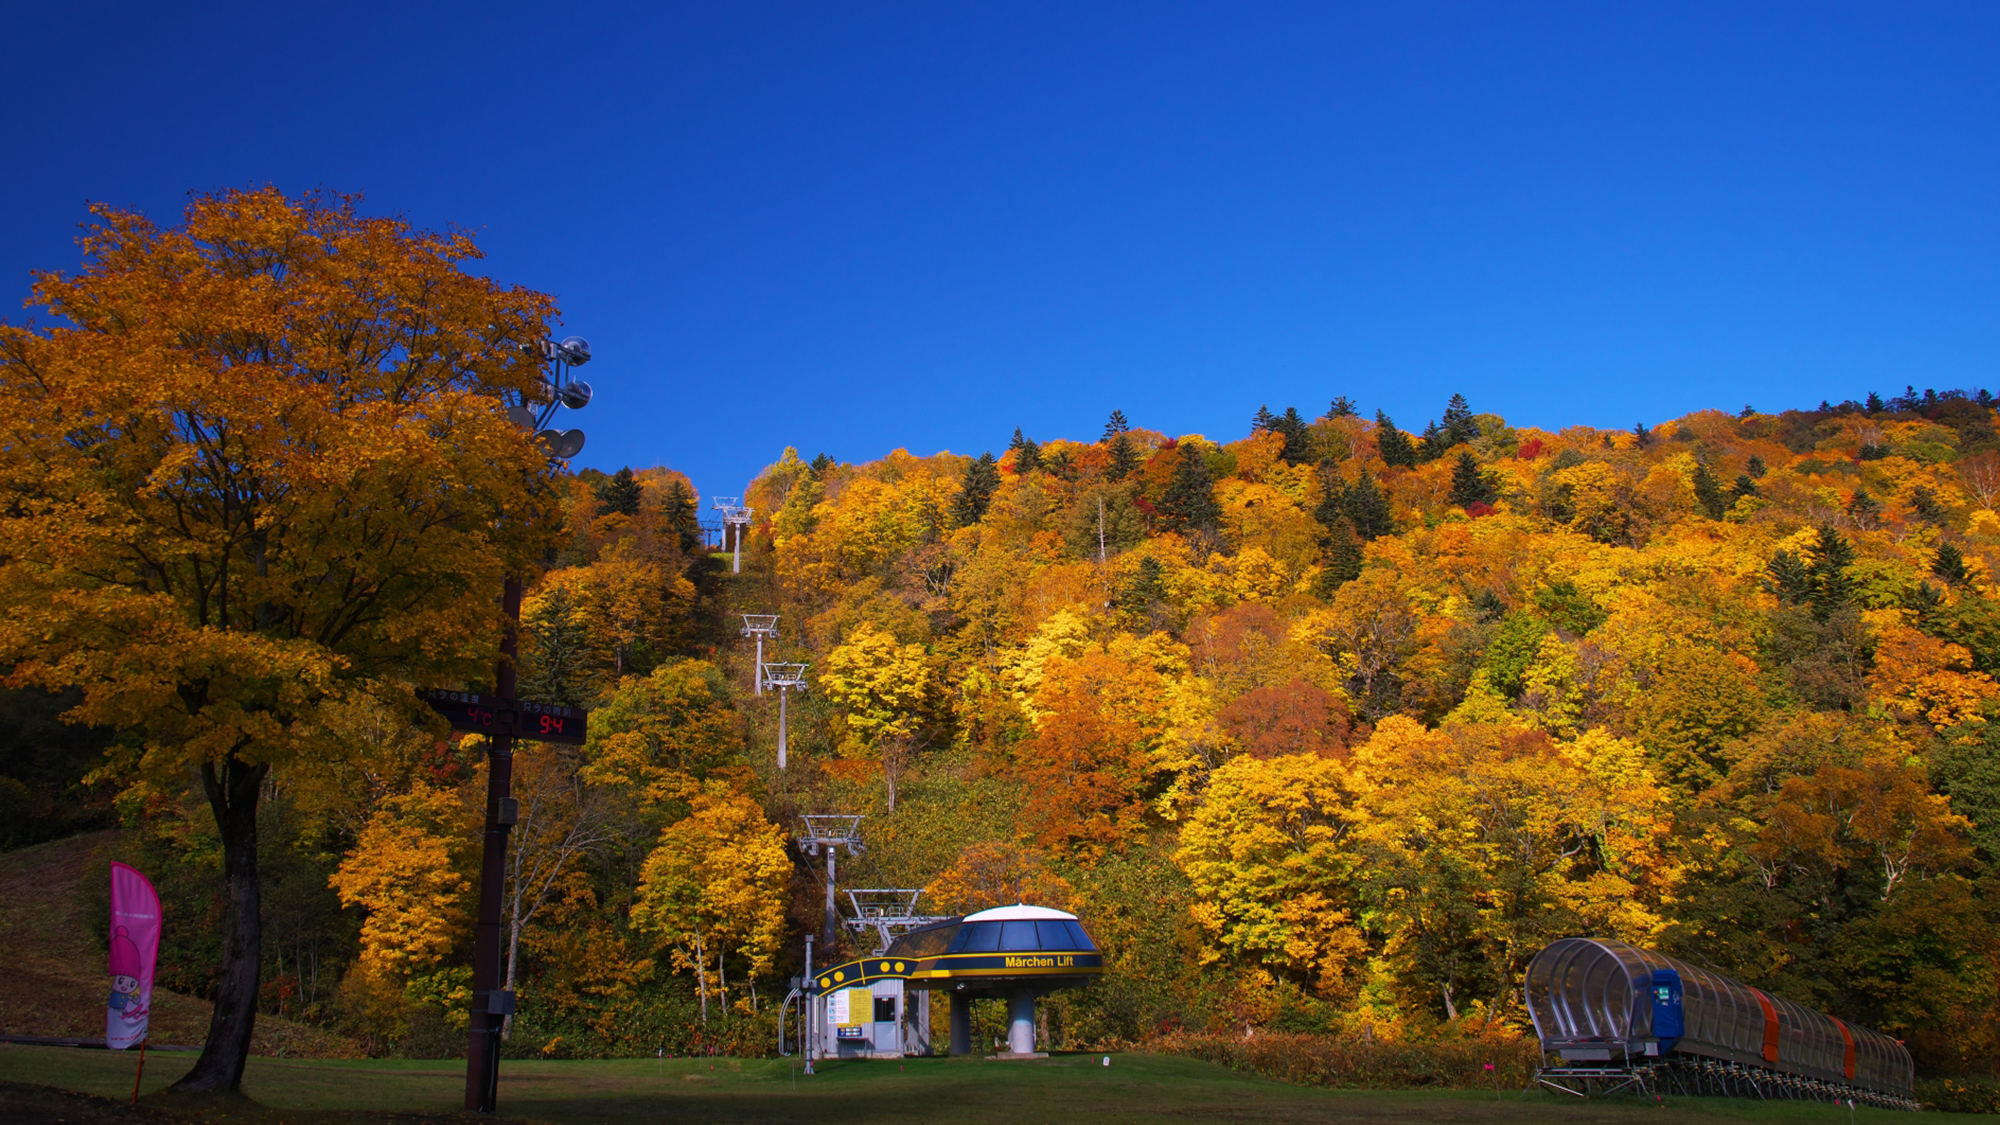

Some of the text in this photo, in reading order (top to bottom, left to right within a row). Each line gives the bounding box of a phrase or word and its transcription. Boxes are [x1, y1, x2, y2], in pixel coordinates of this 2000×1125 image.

[523, 702, 571, 717] 只今の時刻
[1005, 955, 1074, 968] Märchen Lift
